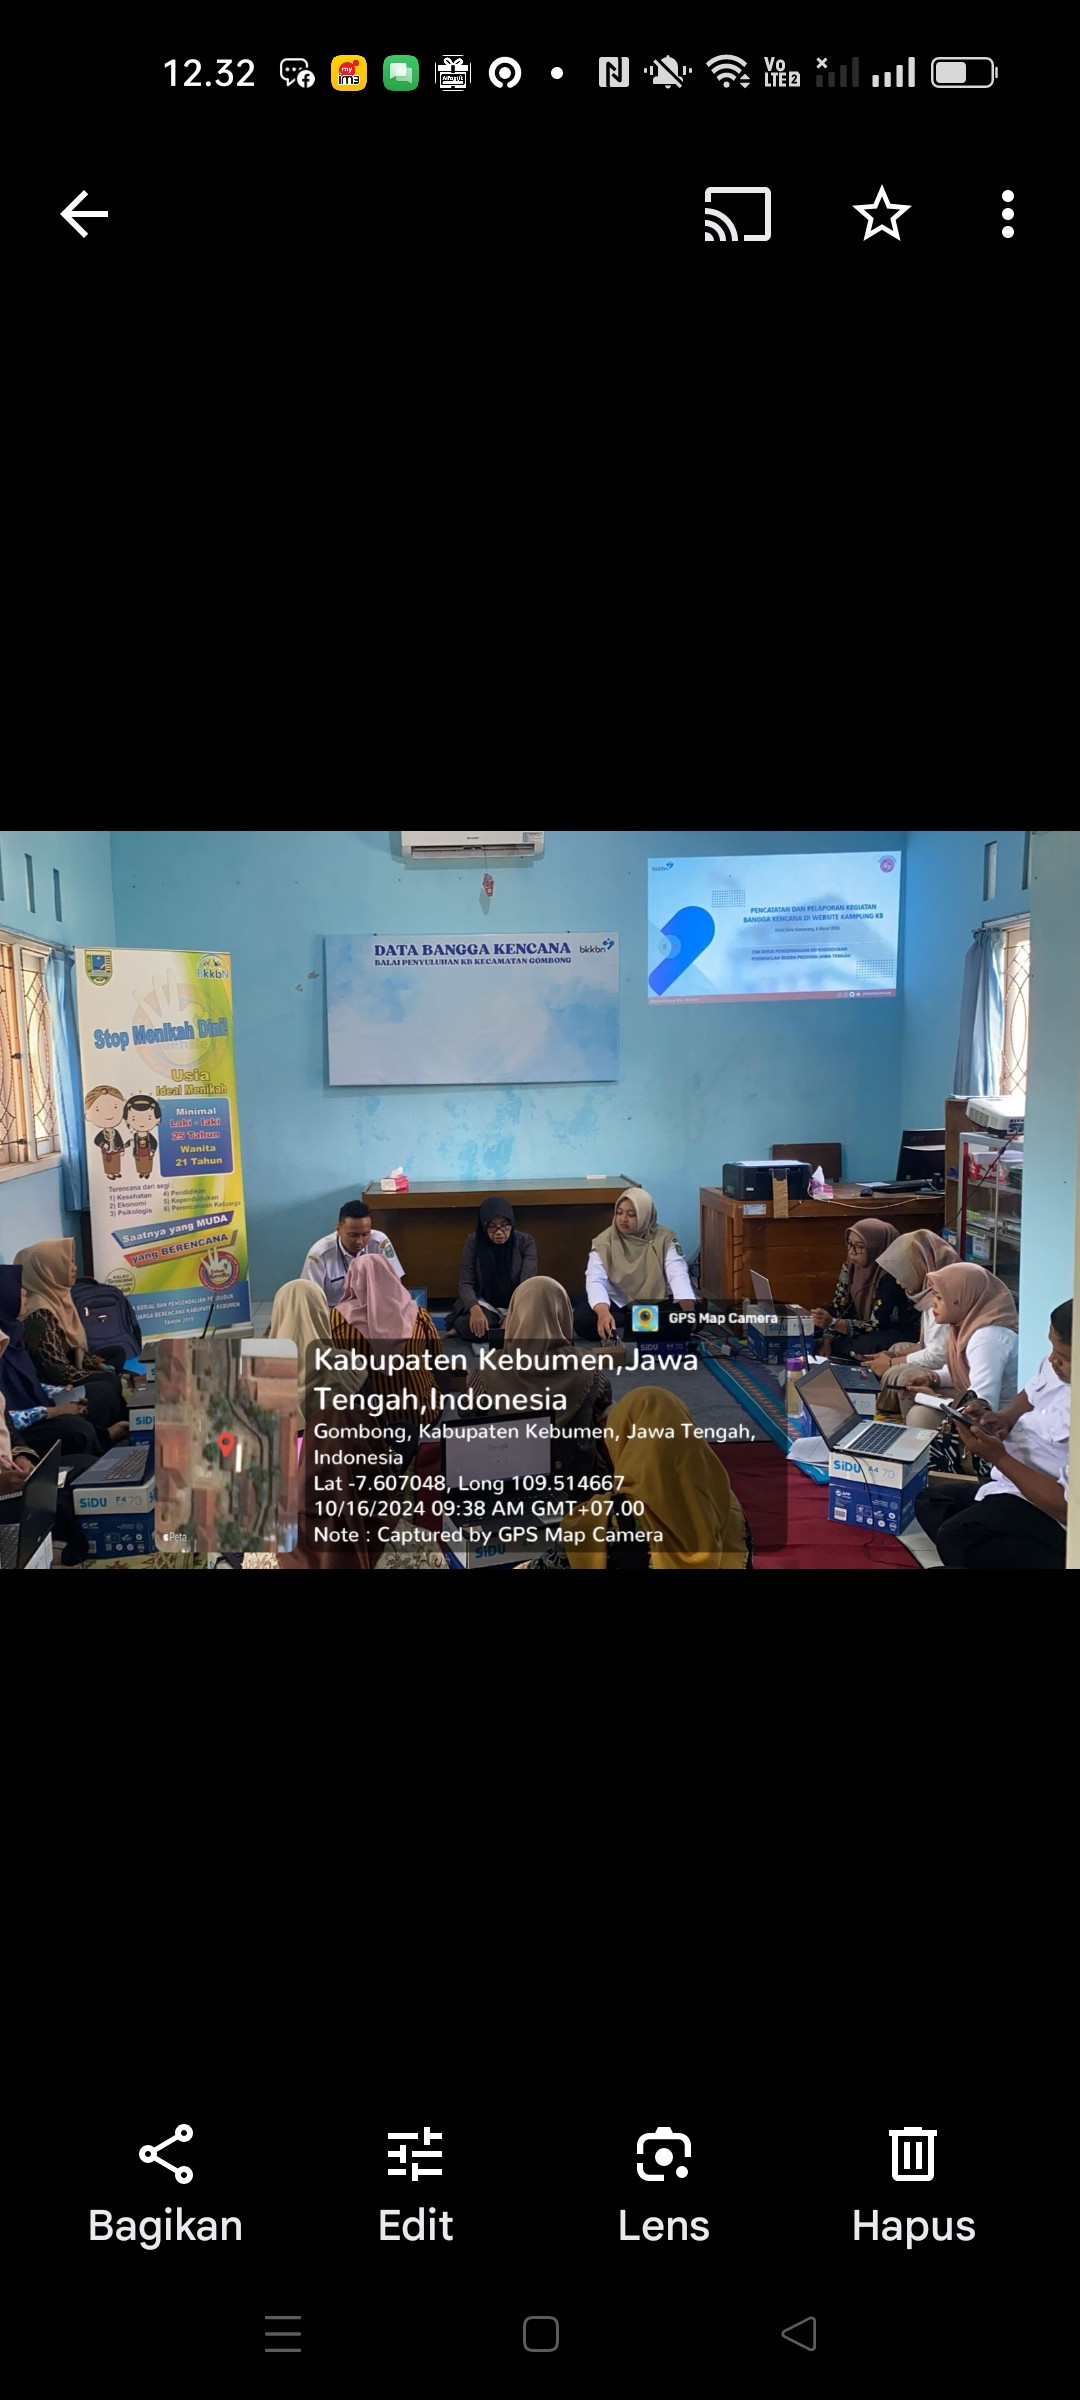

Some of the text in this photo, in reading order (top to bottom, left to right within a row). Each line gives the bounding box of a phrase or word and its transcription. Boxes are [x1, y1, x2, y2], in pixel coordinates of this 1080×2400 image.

[764, 57, 785, 71] Vo
[165, 59, 254, 86] 12.32
[765, 72, 786, 87] LTE
[374, 942, 571, 956] DATA BANGGA KENCANA
[579, 945, 606, 954] bkkbn
[402, 958, 460, 966] PENYULUHAN
[474, 957, 528, 965] KECAMATAN
[197, 968, 229, 979] BkkbN
[94, 1017, 228, 1051] Stop Menikah Dini!
[171, 1069, 210, 1081] Usia
[156, 1084, 227, 1096] Ideal Menikah
[176, 1108, 216, 1116] Minimal
[170, 1119, 192, 1127] Laki
[200, 1118, 220, 1126] laki
[187, 1131, 220, 1139] Tahun
[180, 1145, 216, 1153] Wanita
[191, 1157, 222, 1165] Tahun
[109, 1185, 141, 1193] Terencana
[171, 1188, 206, 1196] Pendidikan
[171, 1195, 218, 1204] Kependudukan
[172, 1202, 212, 1211] Perencanaan
[214, 1200, 240, 1209] Keluarga
[122, 1214, 228, 1244] Saatnya yang MUDA
[132, 1234, 228, 1265] yang BERENCANA
[207, 1294, 234, 1302] PEDUDUK
[833, 1460, 861, 1473] SiDU
[79, 1498, 107, 1508] SiDU
[475, 1544, 506, 1558] SiDU
[90, 2207, 242, 2251] Bagikan
[380, 2207, 454, 2242] Edit
[620, 2209, 710, 2242] Lens
[854, 2209, 976, 2251] Hapus
